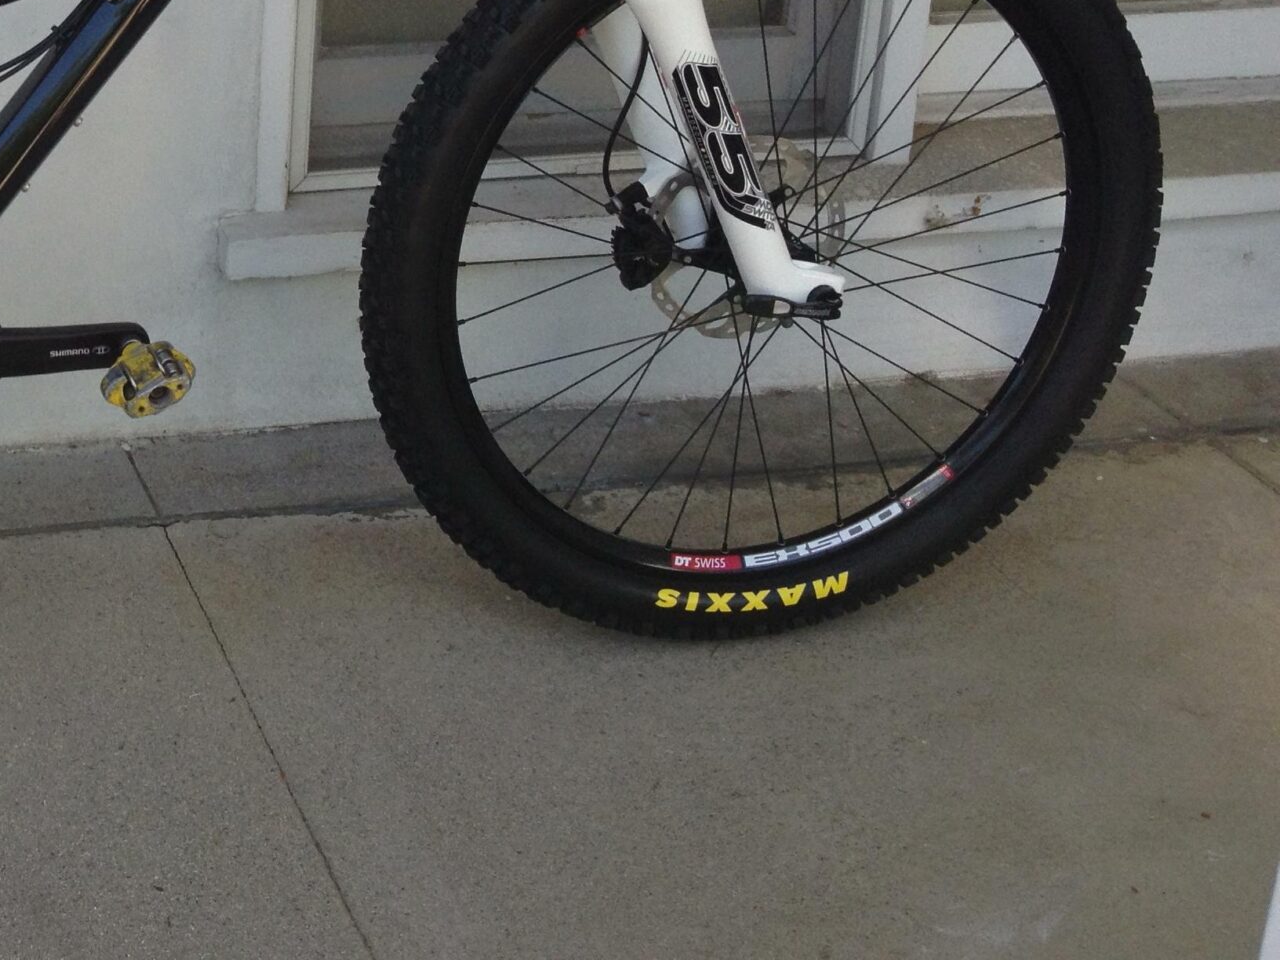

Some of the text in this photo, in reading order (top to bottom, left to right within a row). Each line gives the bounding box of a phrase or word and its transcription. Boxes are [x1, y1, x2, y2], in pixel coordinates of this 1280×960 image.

[681, 62, 763, 197] 55
[49, 348, 90, 358] SHIMANO
[674, 555, 692, 567] DT
[694, 556, 726, 568] SWISS
[655, 571, 849, 613] MAXXIS
